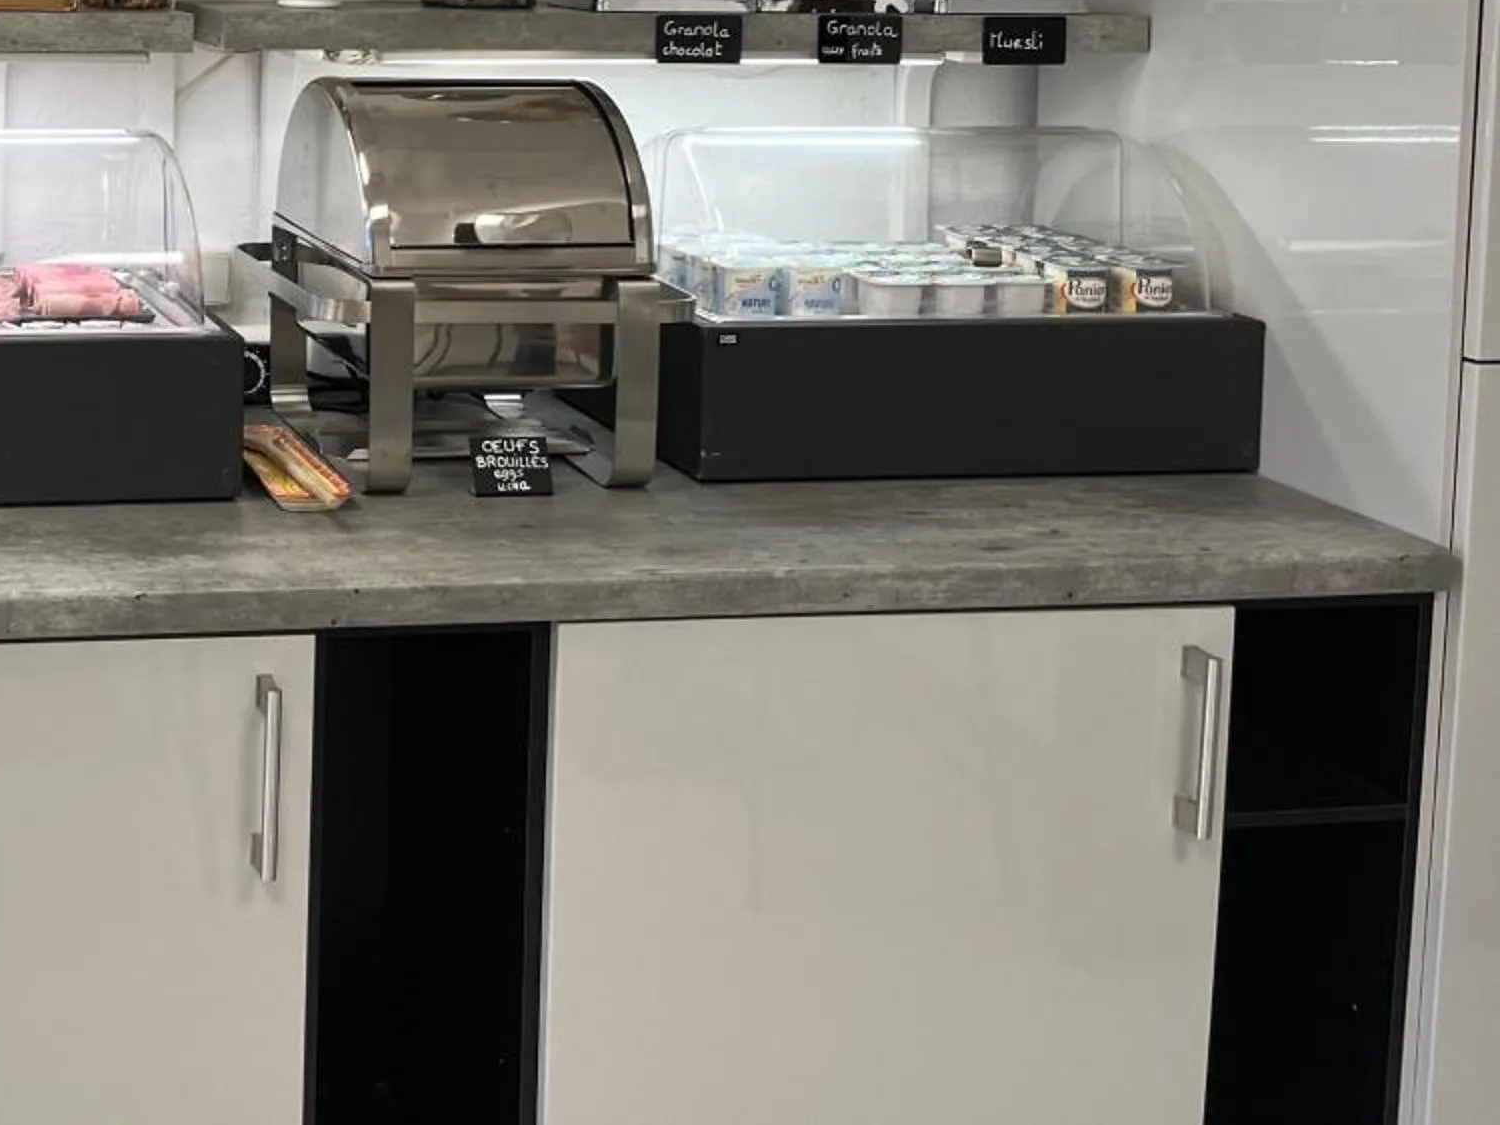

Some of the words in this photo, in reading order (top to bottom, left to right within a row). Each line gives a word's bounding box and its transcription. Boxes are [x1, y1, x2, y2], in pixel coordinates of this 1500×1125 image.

[663, 20, 731, 38] Granola
[827, 19, 898, 38] Granola
[662, 40, 724, 58] chocolat
[989, 30, 1043, 50] Muesli
